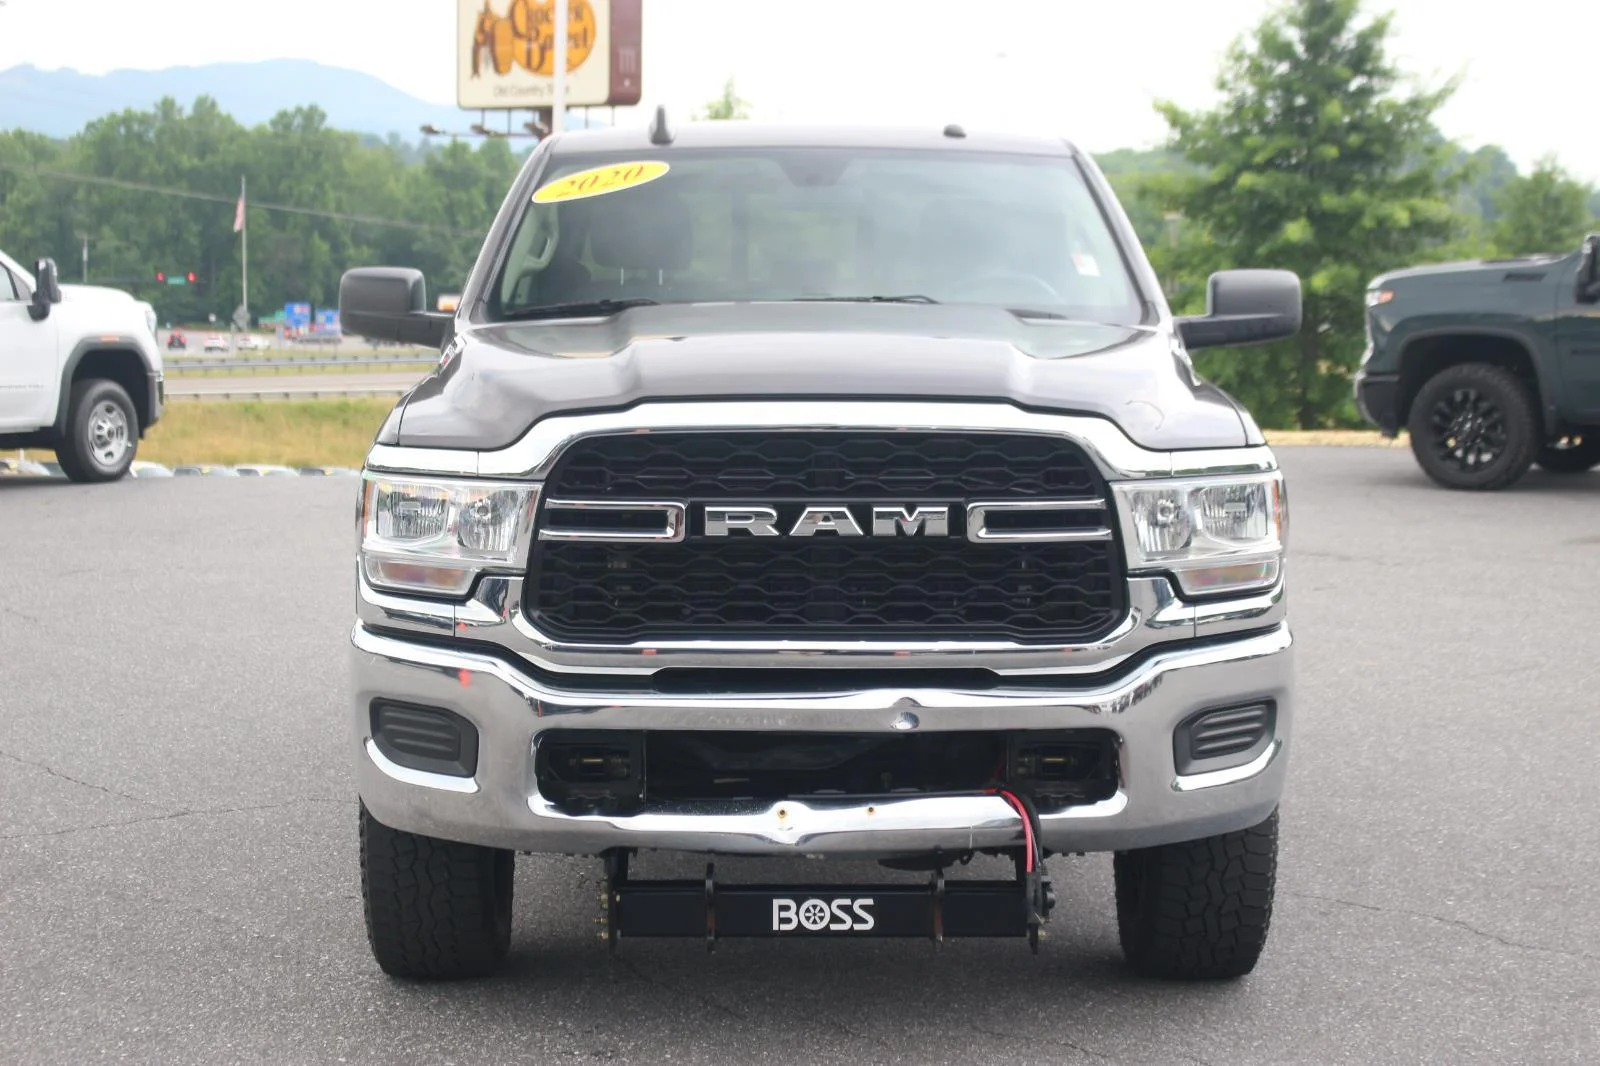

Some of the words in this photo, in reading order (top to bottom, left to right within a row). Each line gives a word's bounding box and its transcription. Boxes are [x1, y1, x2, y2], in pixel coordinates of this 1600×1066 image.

[556, 165, 644, 197] 2020
[704, 505, 949, 537] RAM
[772, 898, 875, 931] BOSS
